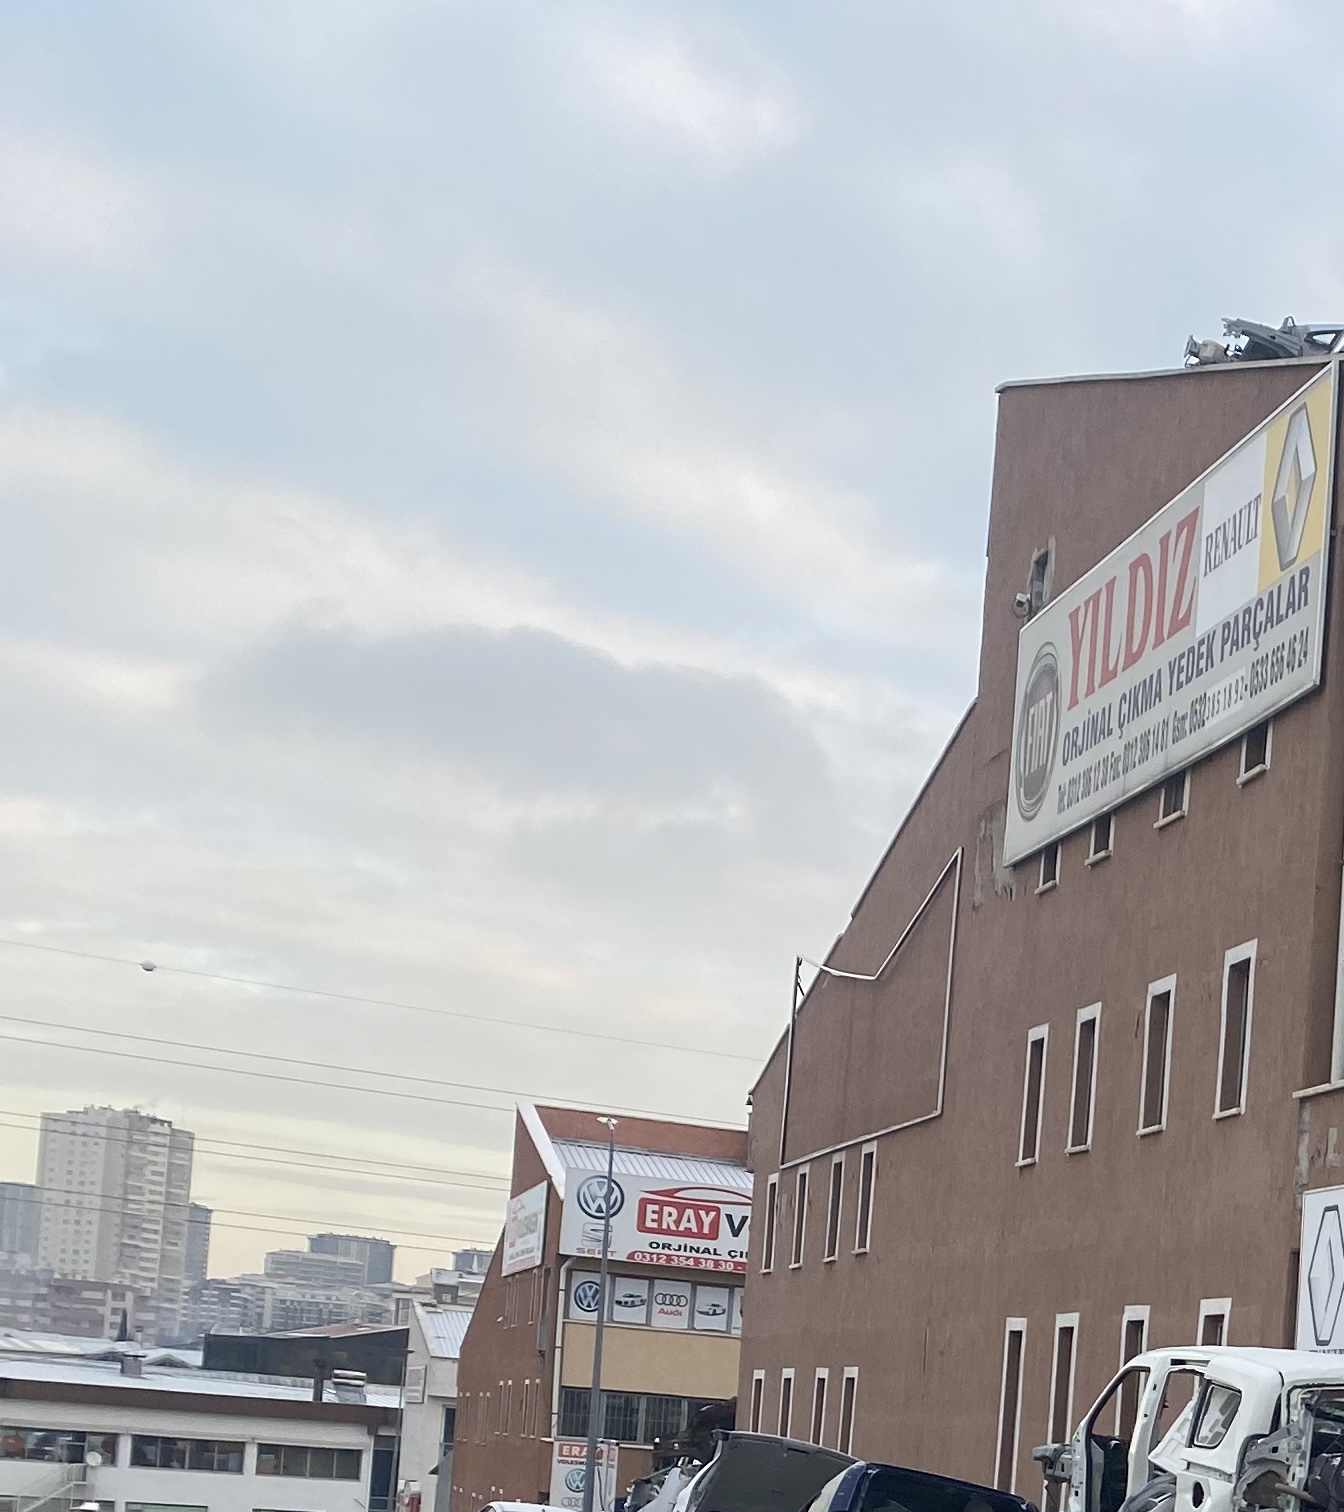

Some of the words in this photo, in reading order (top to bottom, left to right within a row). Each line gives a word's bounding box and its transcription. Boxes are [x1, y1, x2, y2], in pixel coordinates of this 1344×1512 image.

[1203, 492, 1262, 578] RENAULT
[1067, 505, 1200, 711] YILDIZ
[1061, 702, 1113, 767] ORJİNAL
[1117, 667, 1162, 740] ÇIKMA
[1168, 630, 1216, 697] YEDEK
[1219, 565, 1310, 663] PARÇALAR
[1298, 626, 1310, 669] 24
[1023, 692, 1054, 778] FIAT
[645, 1203, 718, 1235] ERAY
[634, 1250, 666, 1263] 0312
[670, 1255, 695, 1267] 354
[698, 1258, 714, 1269] 38
[717, 1259, 735, 1271] 30
[648, 1241, 723, 1257] ORJİNAL
[657, 1307, 682, 1317] Audi
[562, 1444, 588, 1457] ERA
